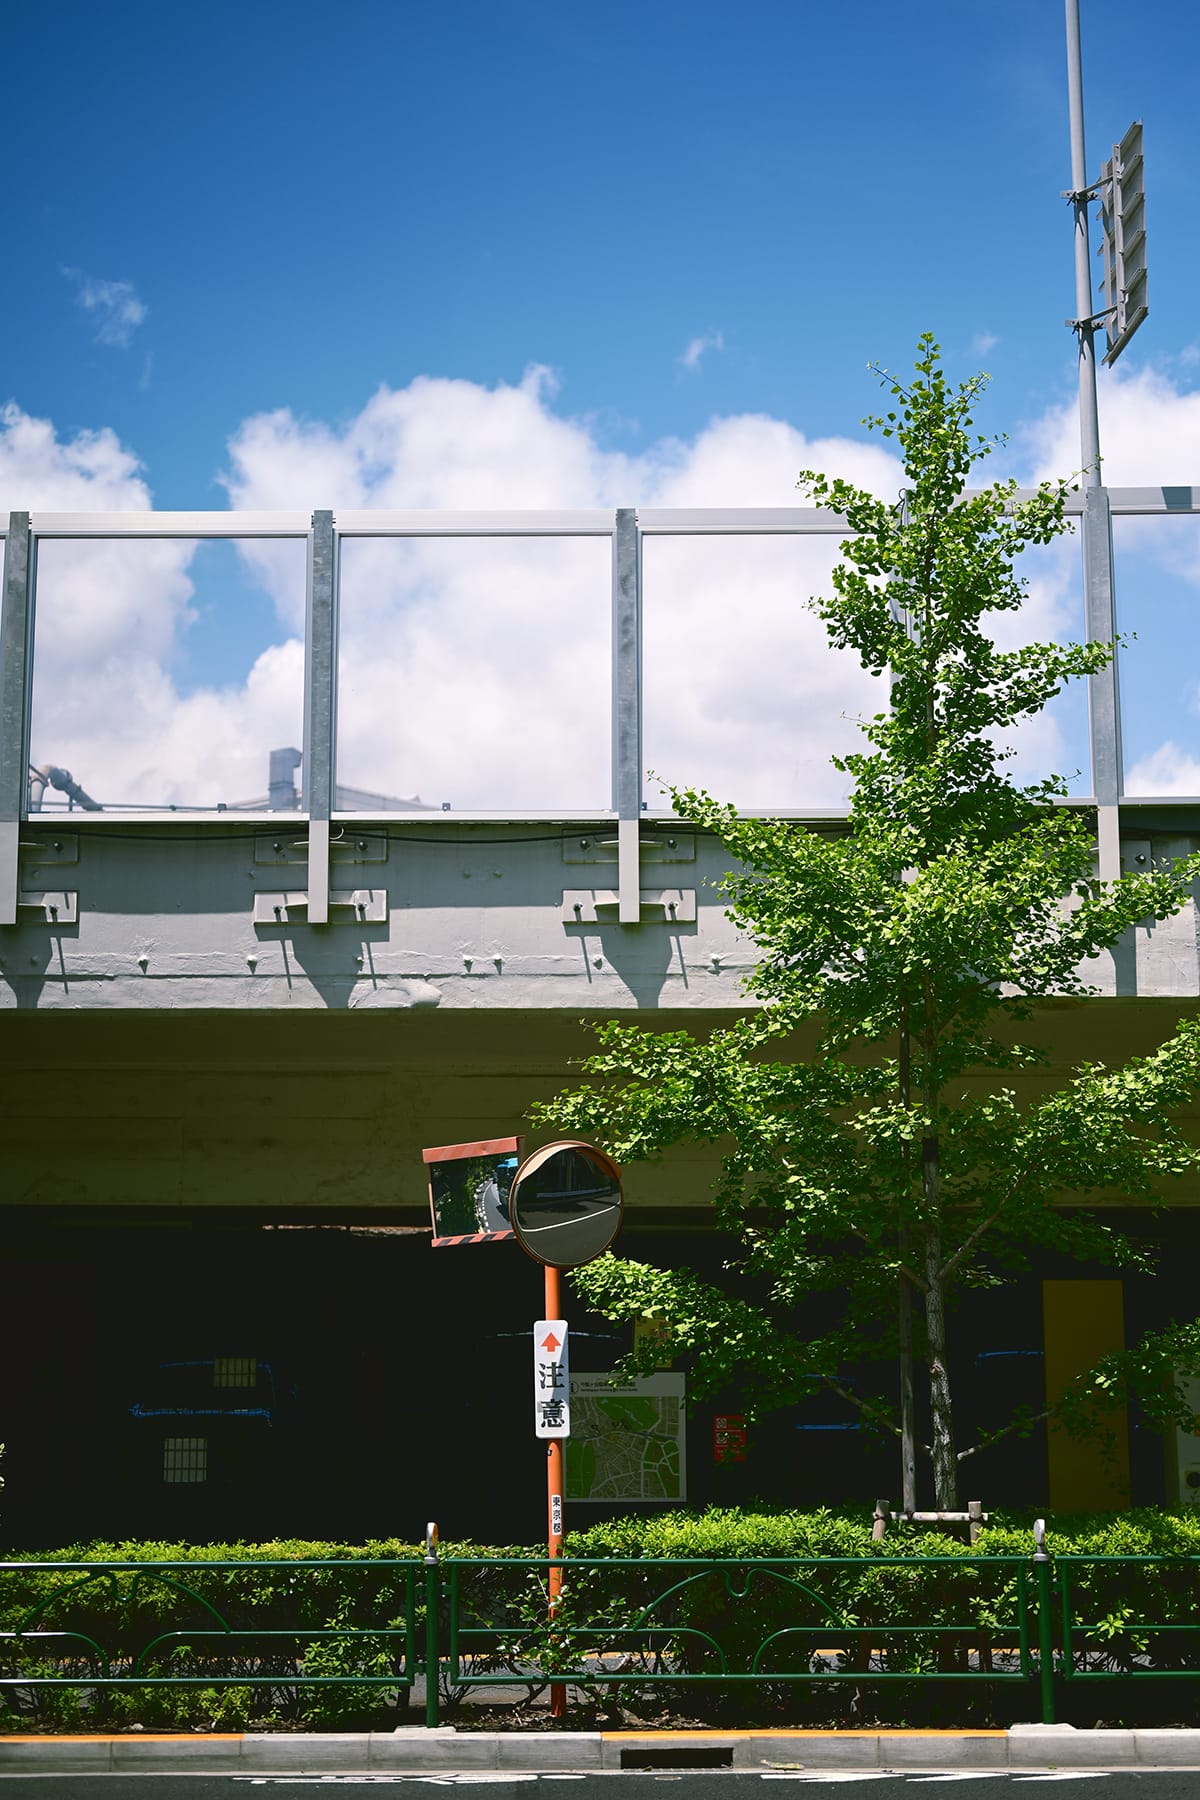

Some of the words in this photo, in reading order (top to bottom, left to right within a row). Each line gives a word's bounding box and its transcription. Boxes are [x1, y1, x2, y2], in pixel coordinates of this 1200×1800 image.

[539, 1361, 565, 1428] 注意
[552, 1496, 561, 1533] 東京都
